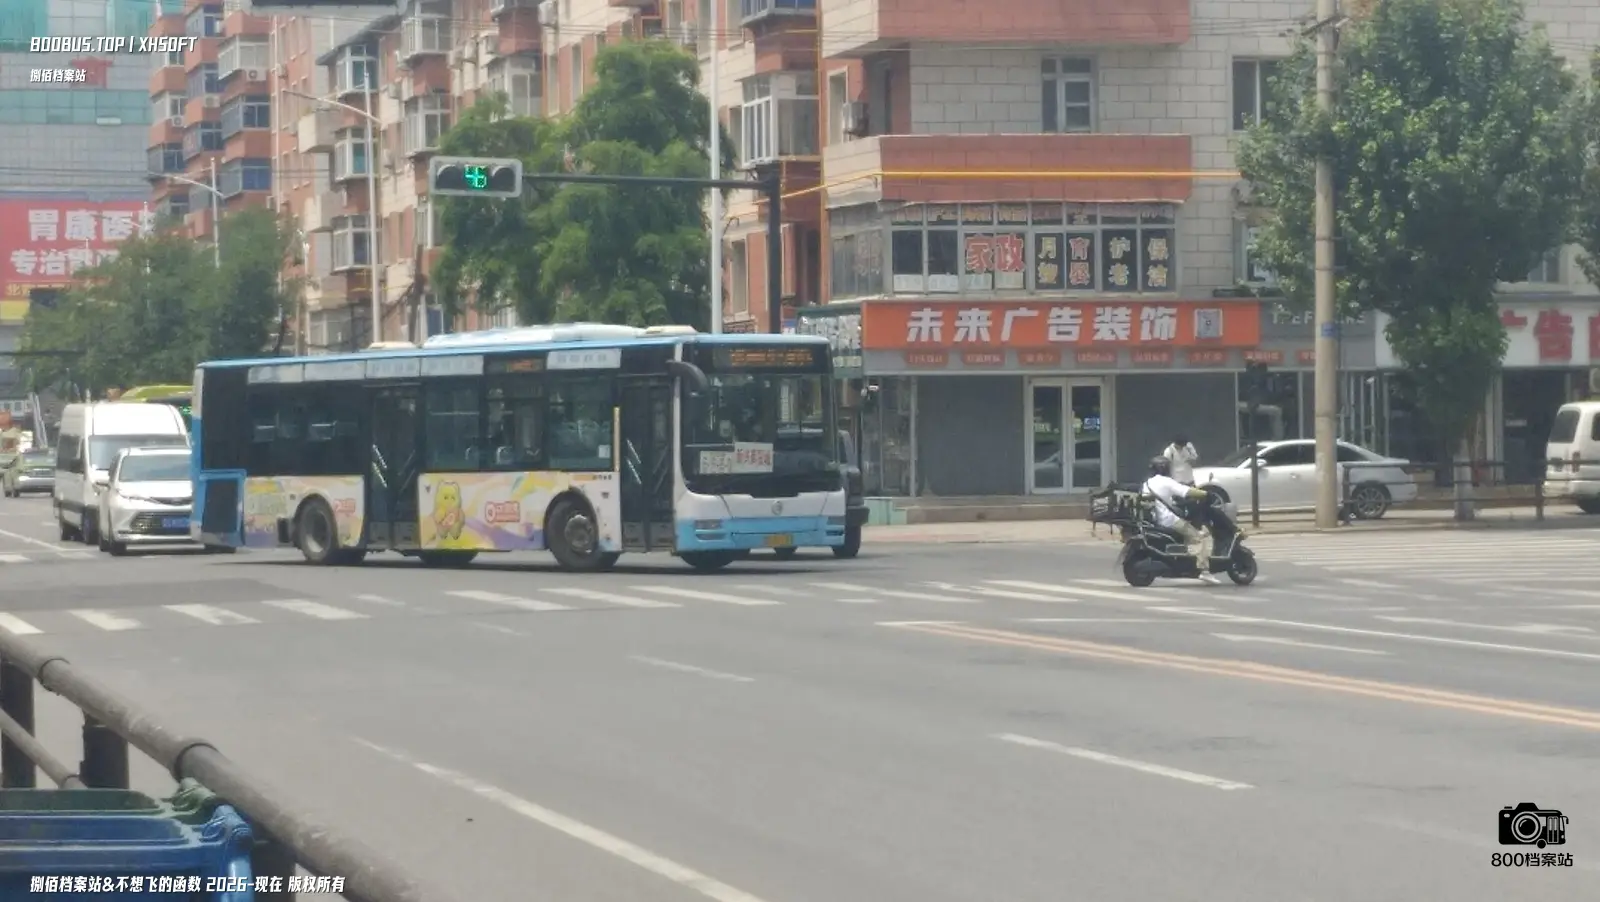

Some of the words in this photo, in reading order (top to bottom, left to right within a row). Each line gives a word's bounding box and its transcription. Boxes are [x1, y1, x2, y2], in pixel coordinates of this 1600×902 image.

[965, 231, 1026, 274] 家政
[906, 307, 1178, 342] 未来广告装饰
